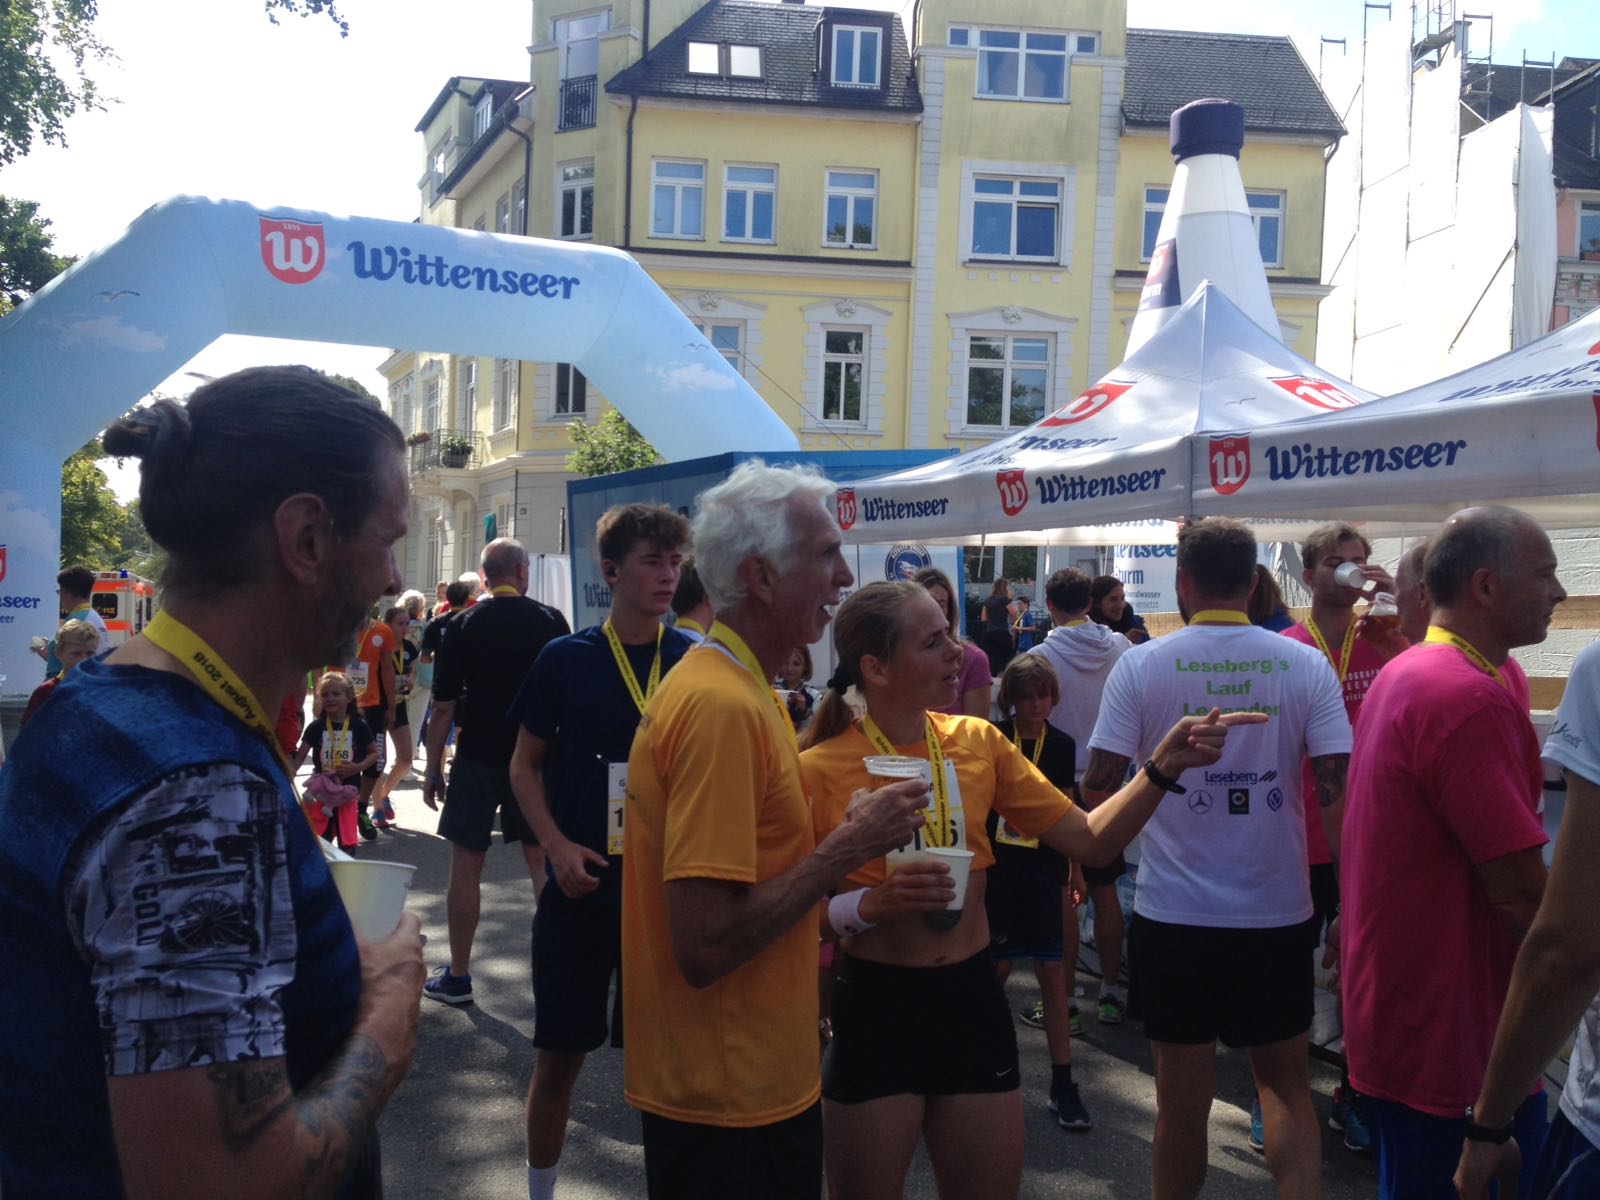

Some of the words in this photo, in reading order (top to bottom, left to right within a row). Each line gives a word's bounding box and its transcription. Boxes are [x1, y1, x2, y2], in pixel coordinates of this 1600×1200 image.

[347, 240, 580, 300] Wittenseer
[1265, 439, 1467, 481] Wittenseer
[1035, 467, 1167, 505] Wittenseer
[862, 496, 949, 522] Wittenseer
[0, 595, 41, 609] seer
[193, 651, 222, 682] 2018
[220, 680, 256, 720] August
[1206, 679, 1253, 696] Lauf
[1205, 770, 1258, 785] Leseberg
[614, 807, 624, 828] 1
